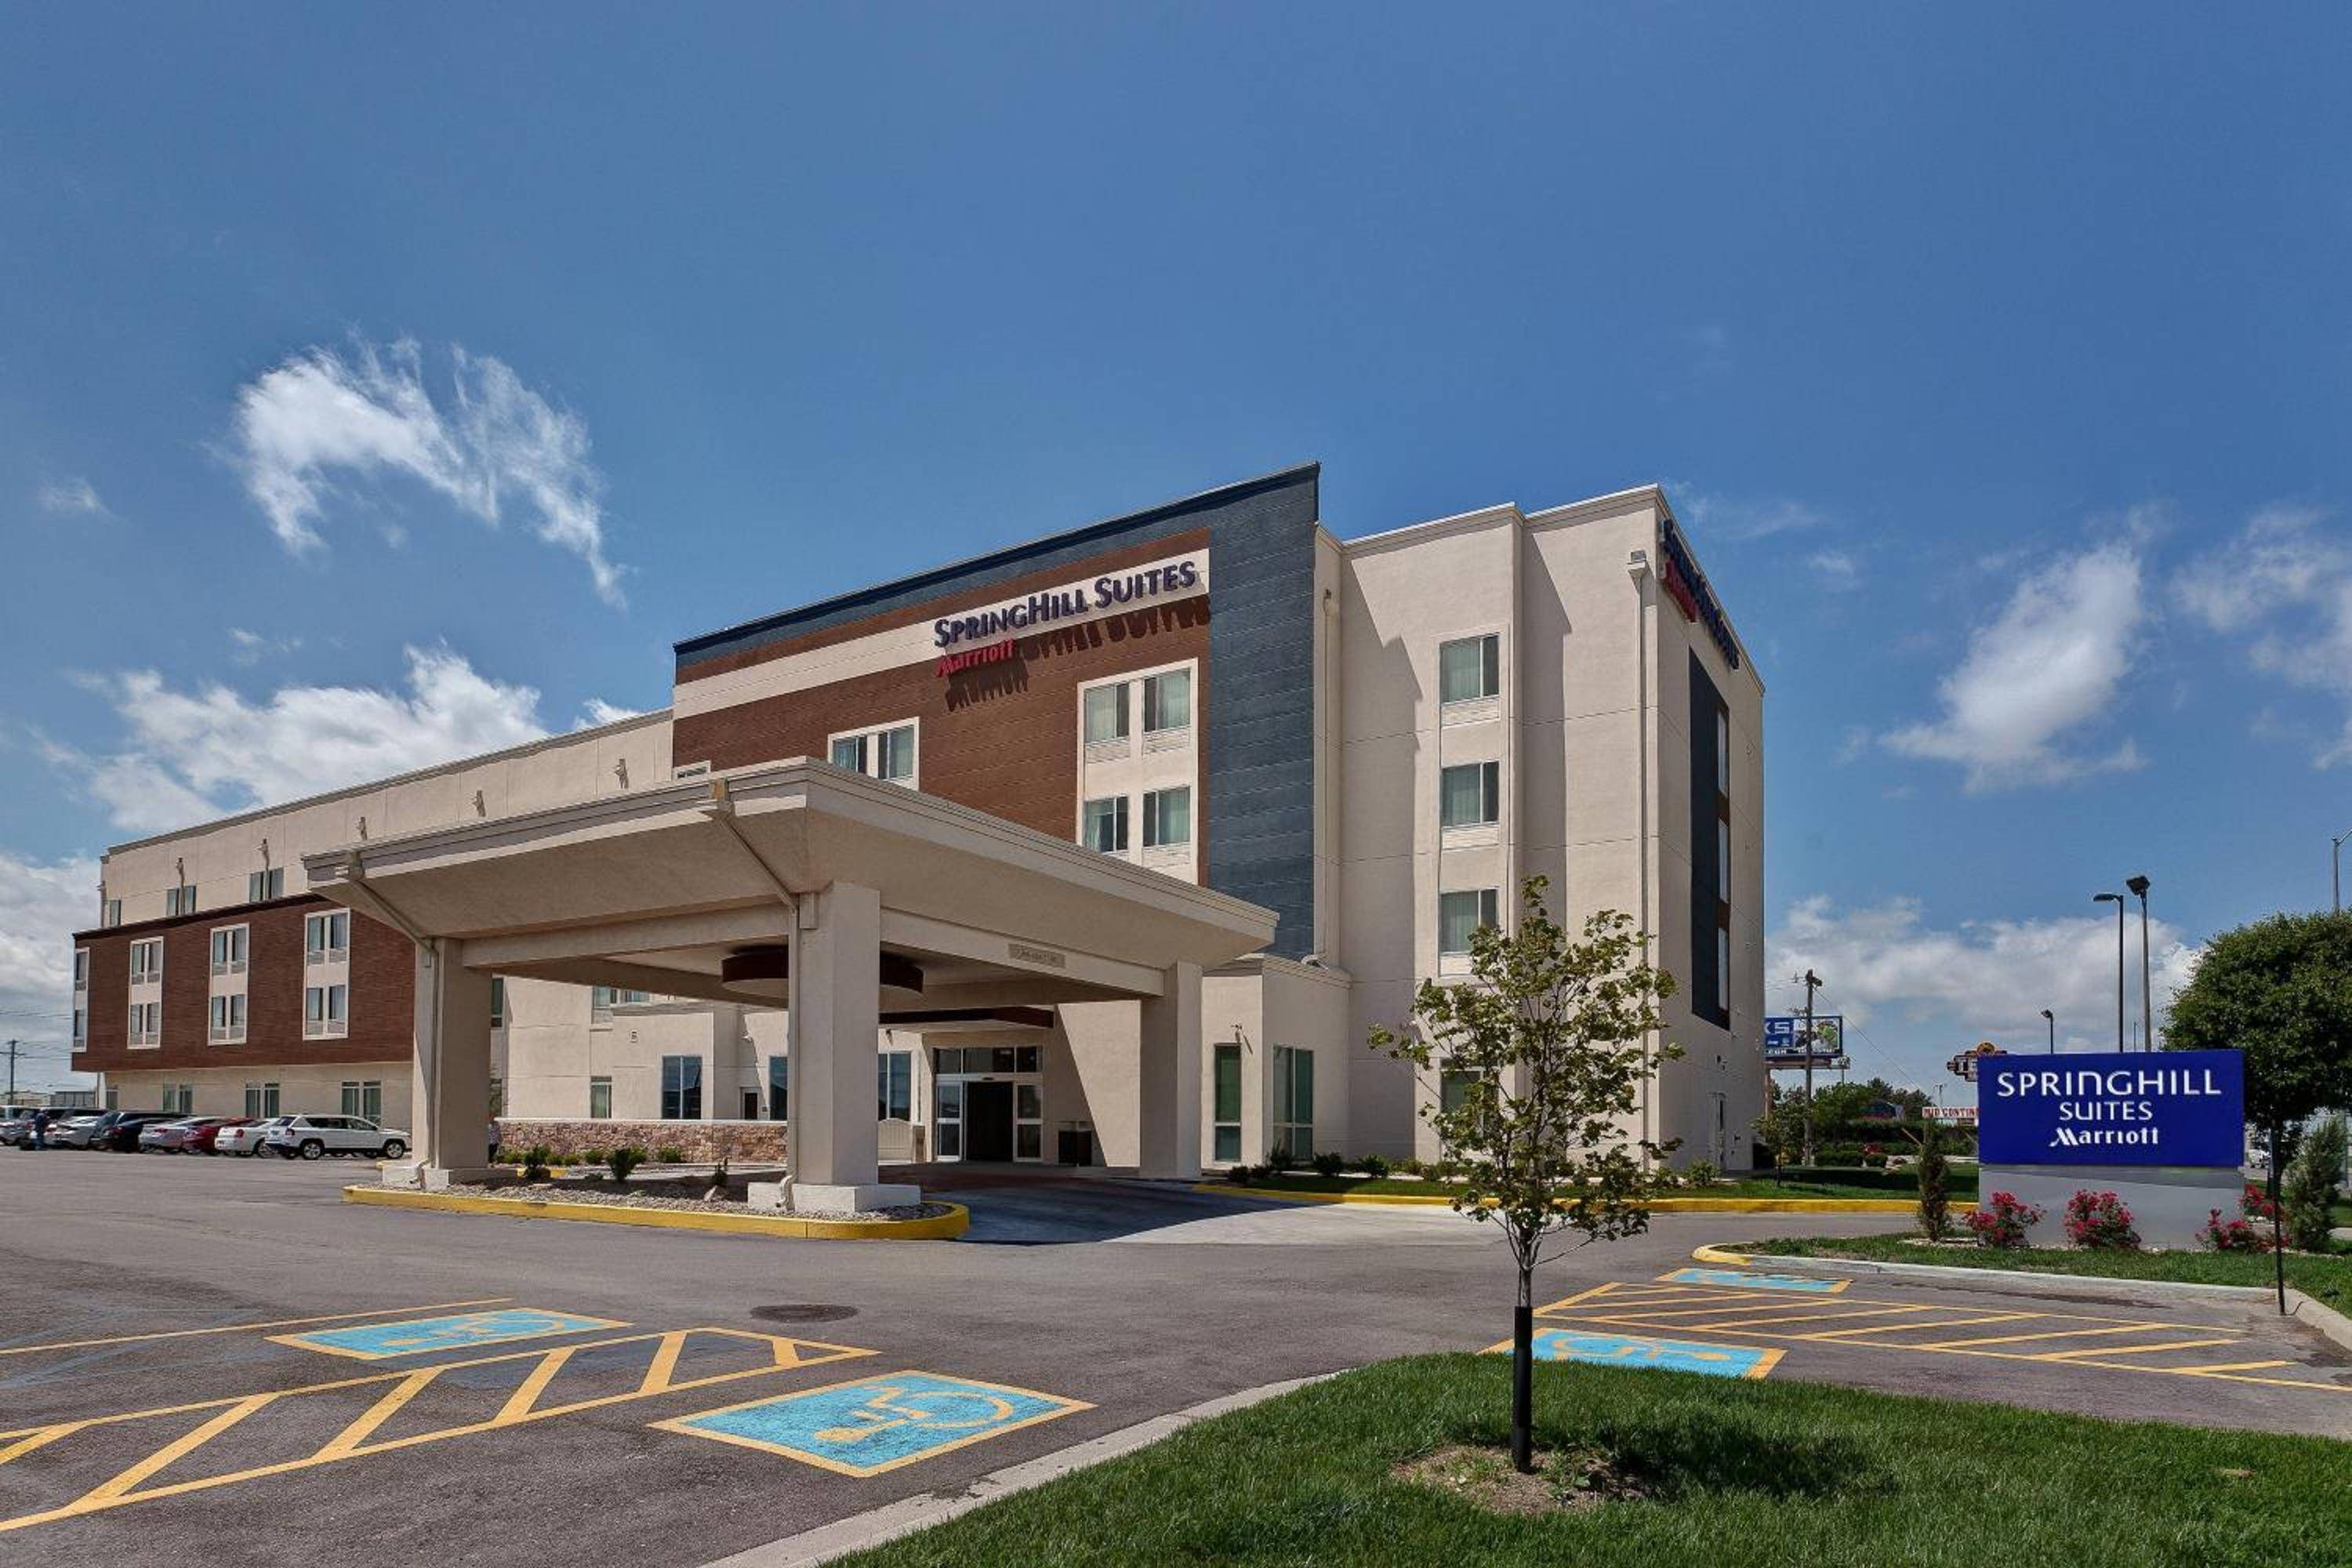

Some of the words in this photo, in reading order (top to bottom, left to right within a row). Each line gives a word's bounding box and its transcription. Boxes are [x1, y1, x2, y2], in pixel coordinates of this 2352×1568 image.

[934, 589, 1088, 648] SPRINGHILL
[1094, 561, 1196, 609] SUITES
[933, 637, 1015, 677] Marriott
[1996, 1069, 2222, 1097] SPRINGHILL
[2059, 1101, 2153, 1121] SUITES
[2048, 1127, 2158, 1147] Marriott
